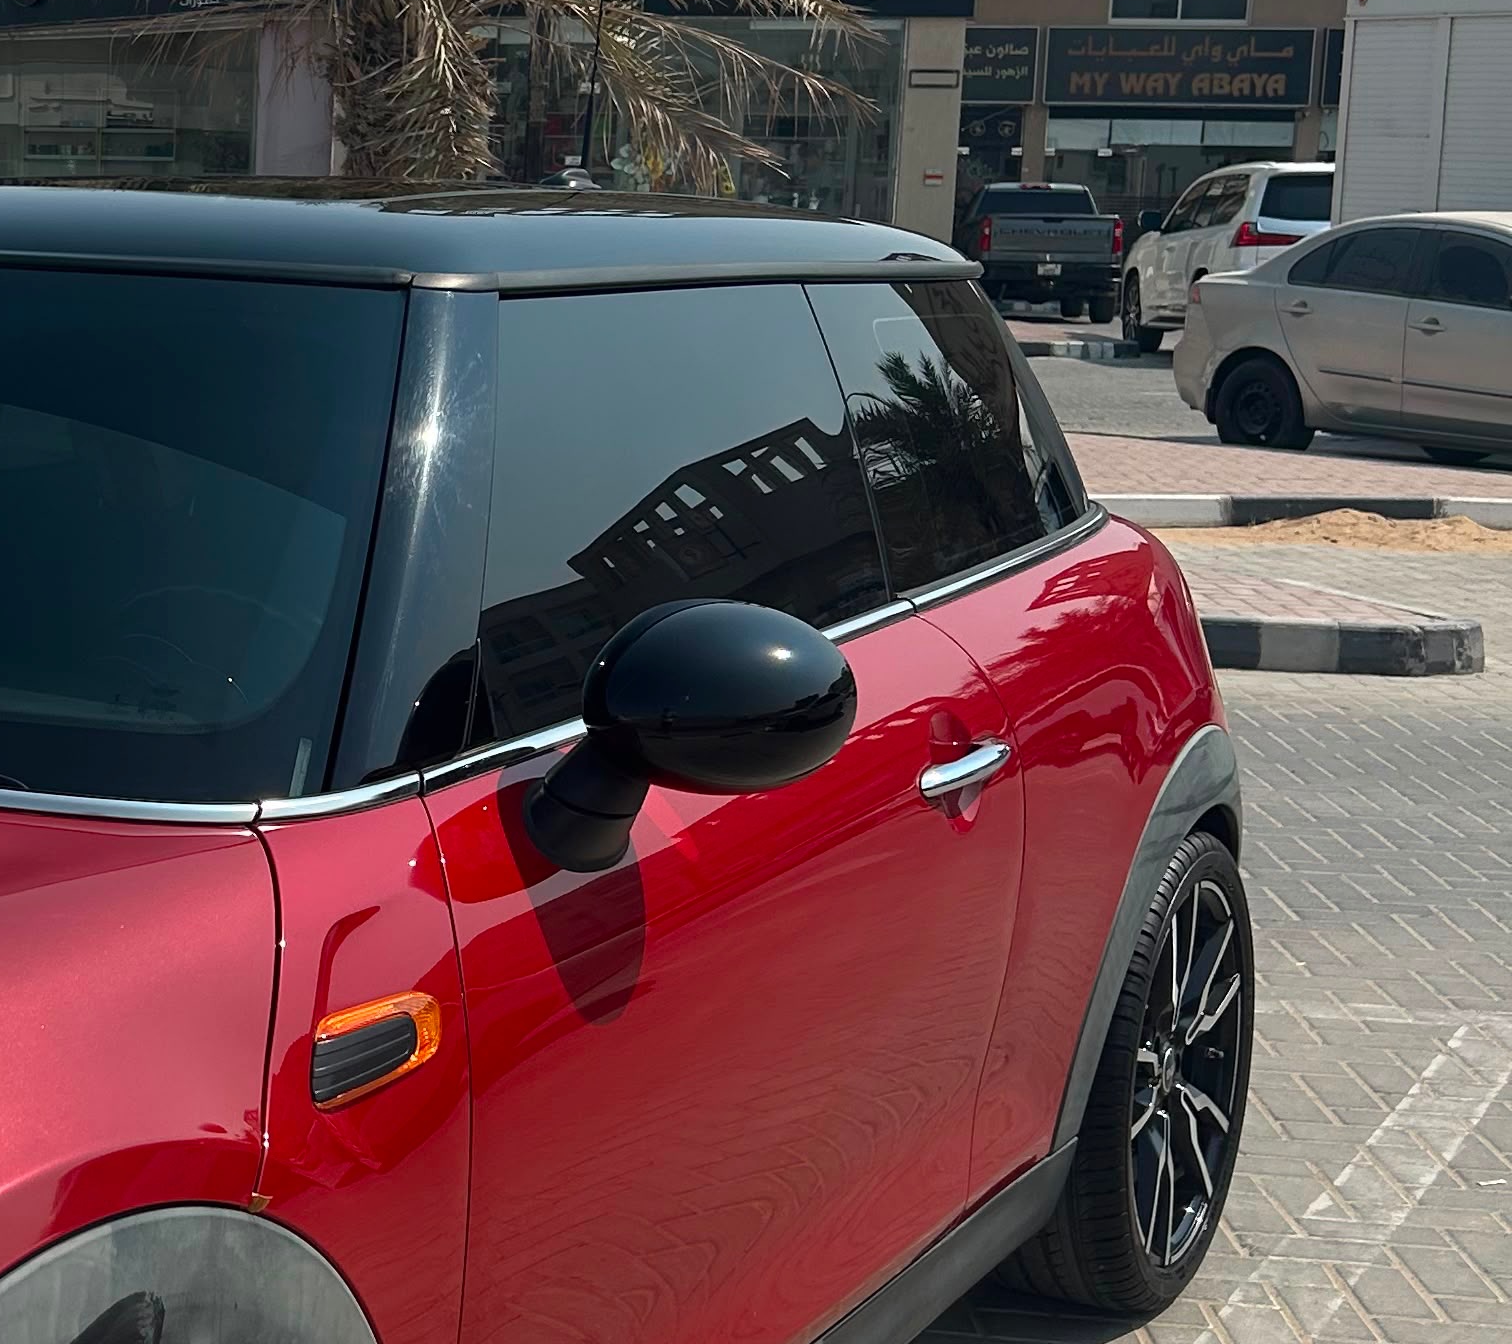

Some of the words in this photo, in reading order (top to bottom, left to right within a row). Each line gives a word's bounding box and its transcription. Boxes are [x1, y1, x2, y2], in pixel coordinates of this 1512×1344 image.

[1070, 71, 1109, 96] MY
[1119, 71, 1182, 96] WAY
[1191, 72, 1286, 97] ABAYA
